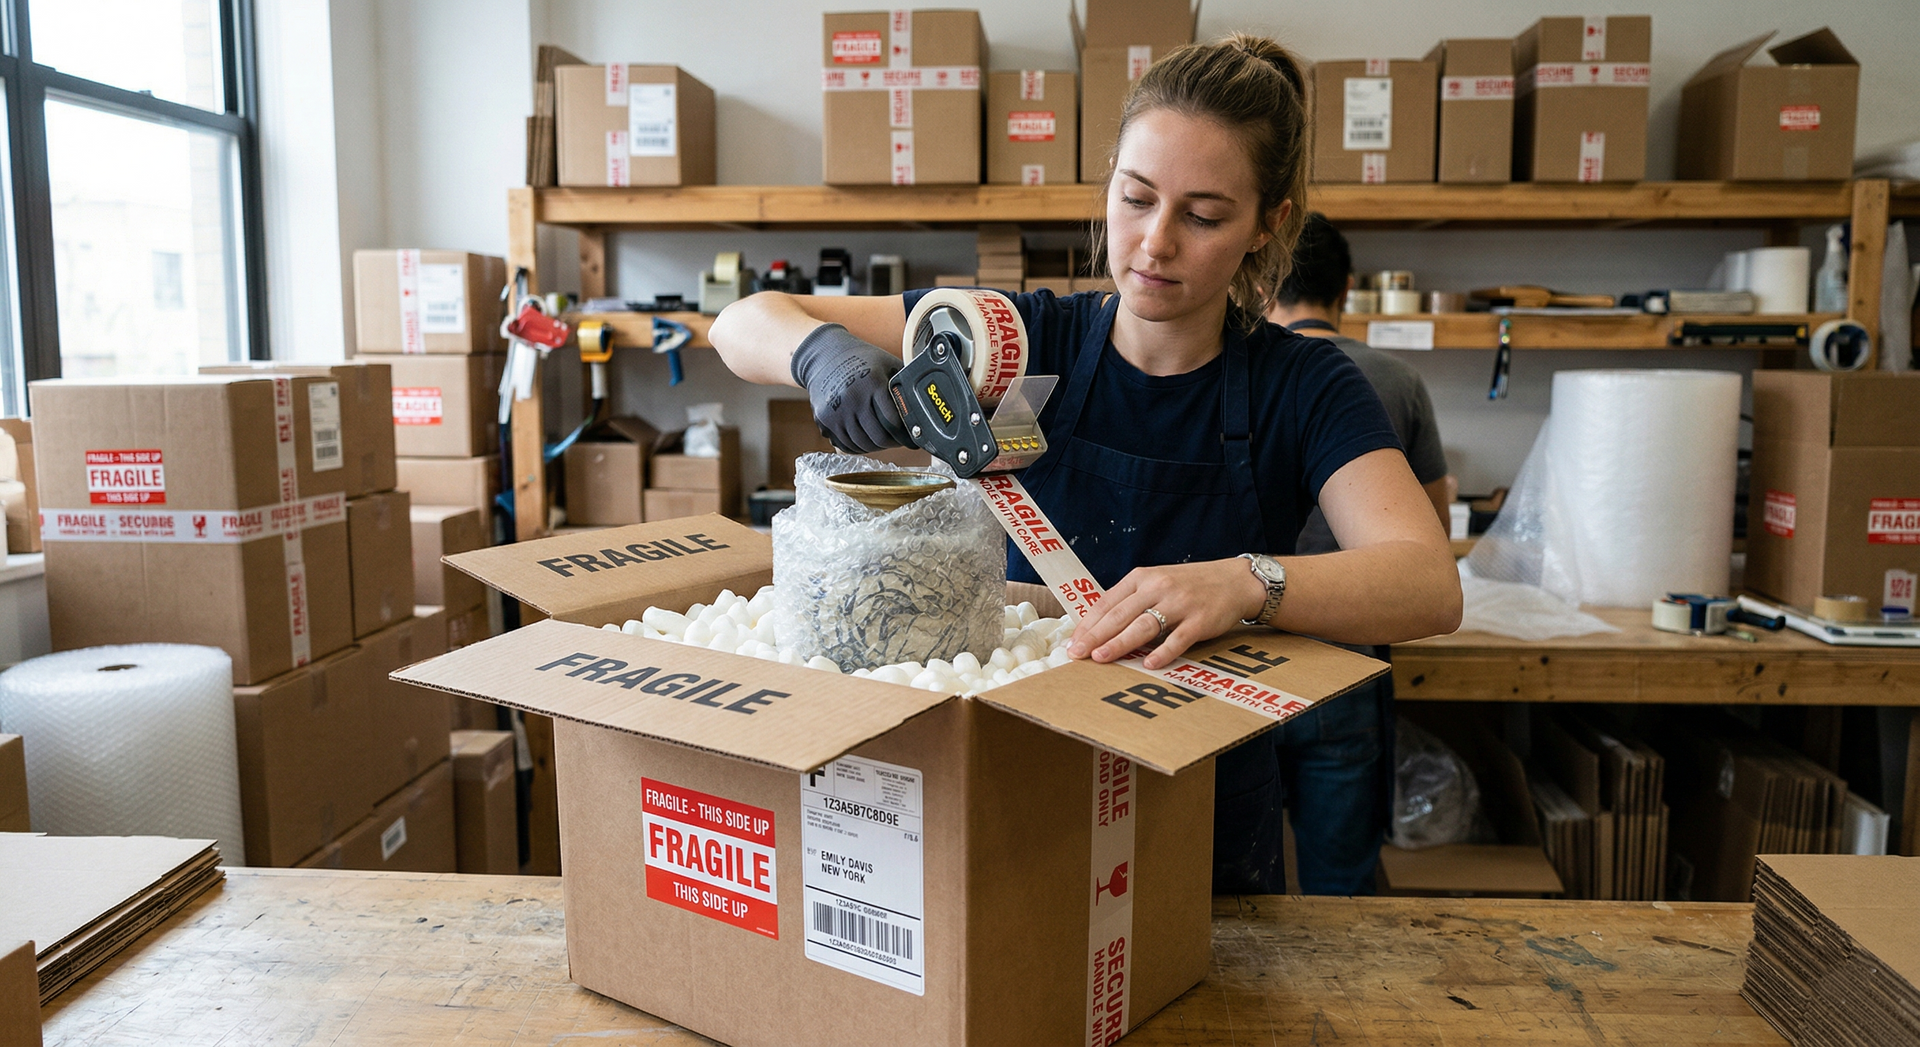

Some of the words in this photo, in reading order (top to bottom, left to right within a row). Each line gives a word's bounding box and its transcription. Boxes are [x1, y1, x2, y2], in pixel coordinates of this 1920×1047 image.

[982, 297, 1022, 398] FRAGILE
[985, 351, 999, 383] WITH
[927, 384, 953, 423] Scotch
[90, 469, 162, 487] FRAGILE
[57, 514, 106, 527] FRAGILE
[537, 533, 731, 579] FRAGILE
[1017, 528, 1043, 556] CARE
[535, 651, 792, 716] FRAGILE
[1163, 671, 1223, 695] HANDLE
[1225, 690, 1262, 709] WITH
[1173, 663, 1308, 714] FRAGILE
[645, 788, 689, 815] FRAGILE
[698, 802, 723, 824] THIS
[725, 809, 751, 831] SIDE
[753, 817, 770, 837] UP
[823, 797, 899, 827] 1Z3A5B7C8D9E
[1098, 788, 1110, 828] ONLY
[648, 821, 771, 894] FRAGILE
[821, 850, 846, 866] EMILY
[848, 857, 874, 874] DAVIS
[821, 862, 841, 877] NEW
[842, 867, 866, 884] YORK
[673, 881, 700, 905] THIS
[702, 889, 729, 912] SIDE
[731, 897, 749, 919] UP
[1091, 948, 1105, 1017] HANDLE
[1104, 936, 1126, 1047] SECURE
